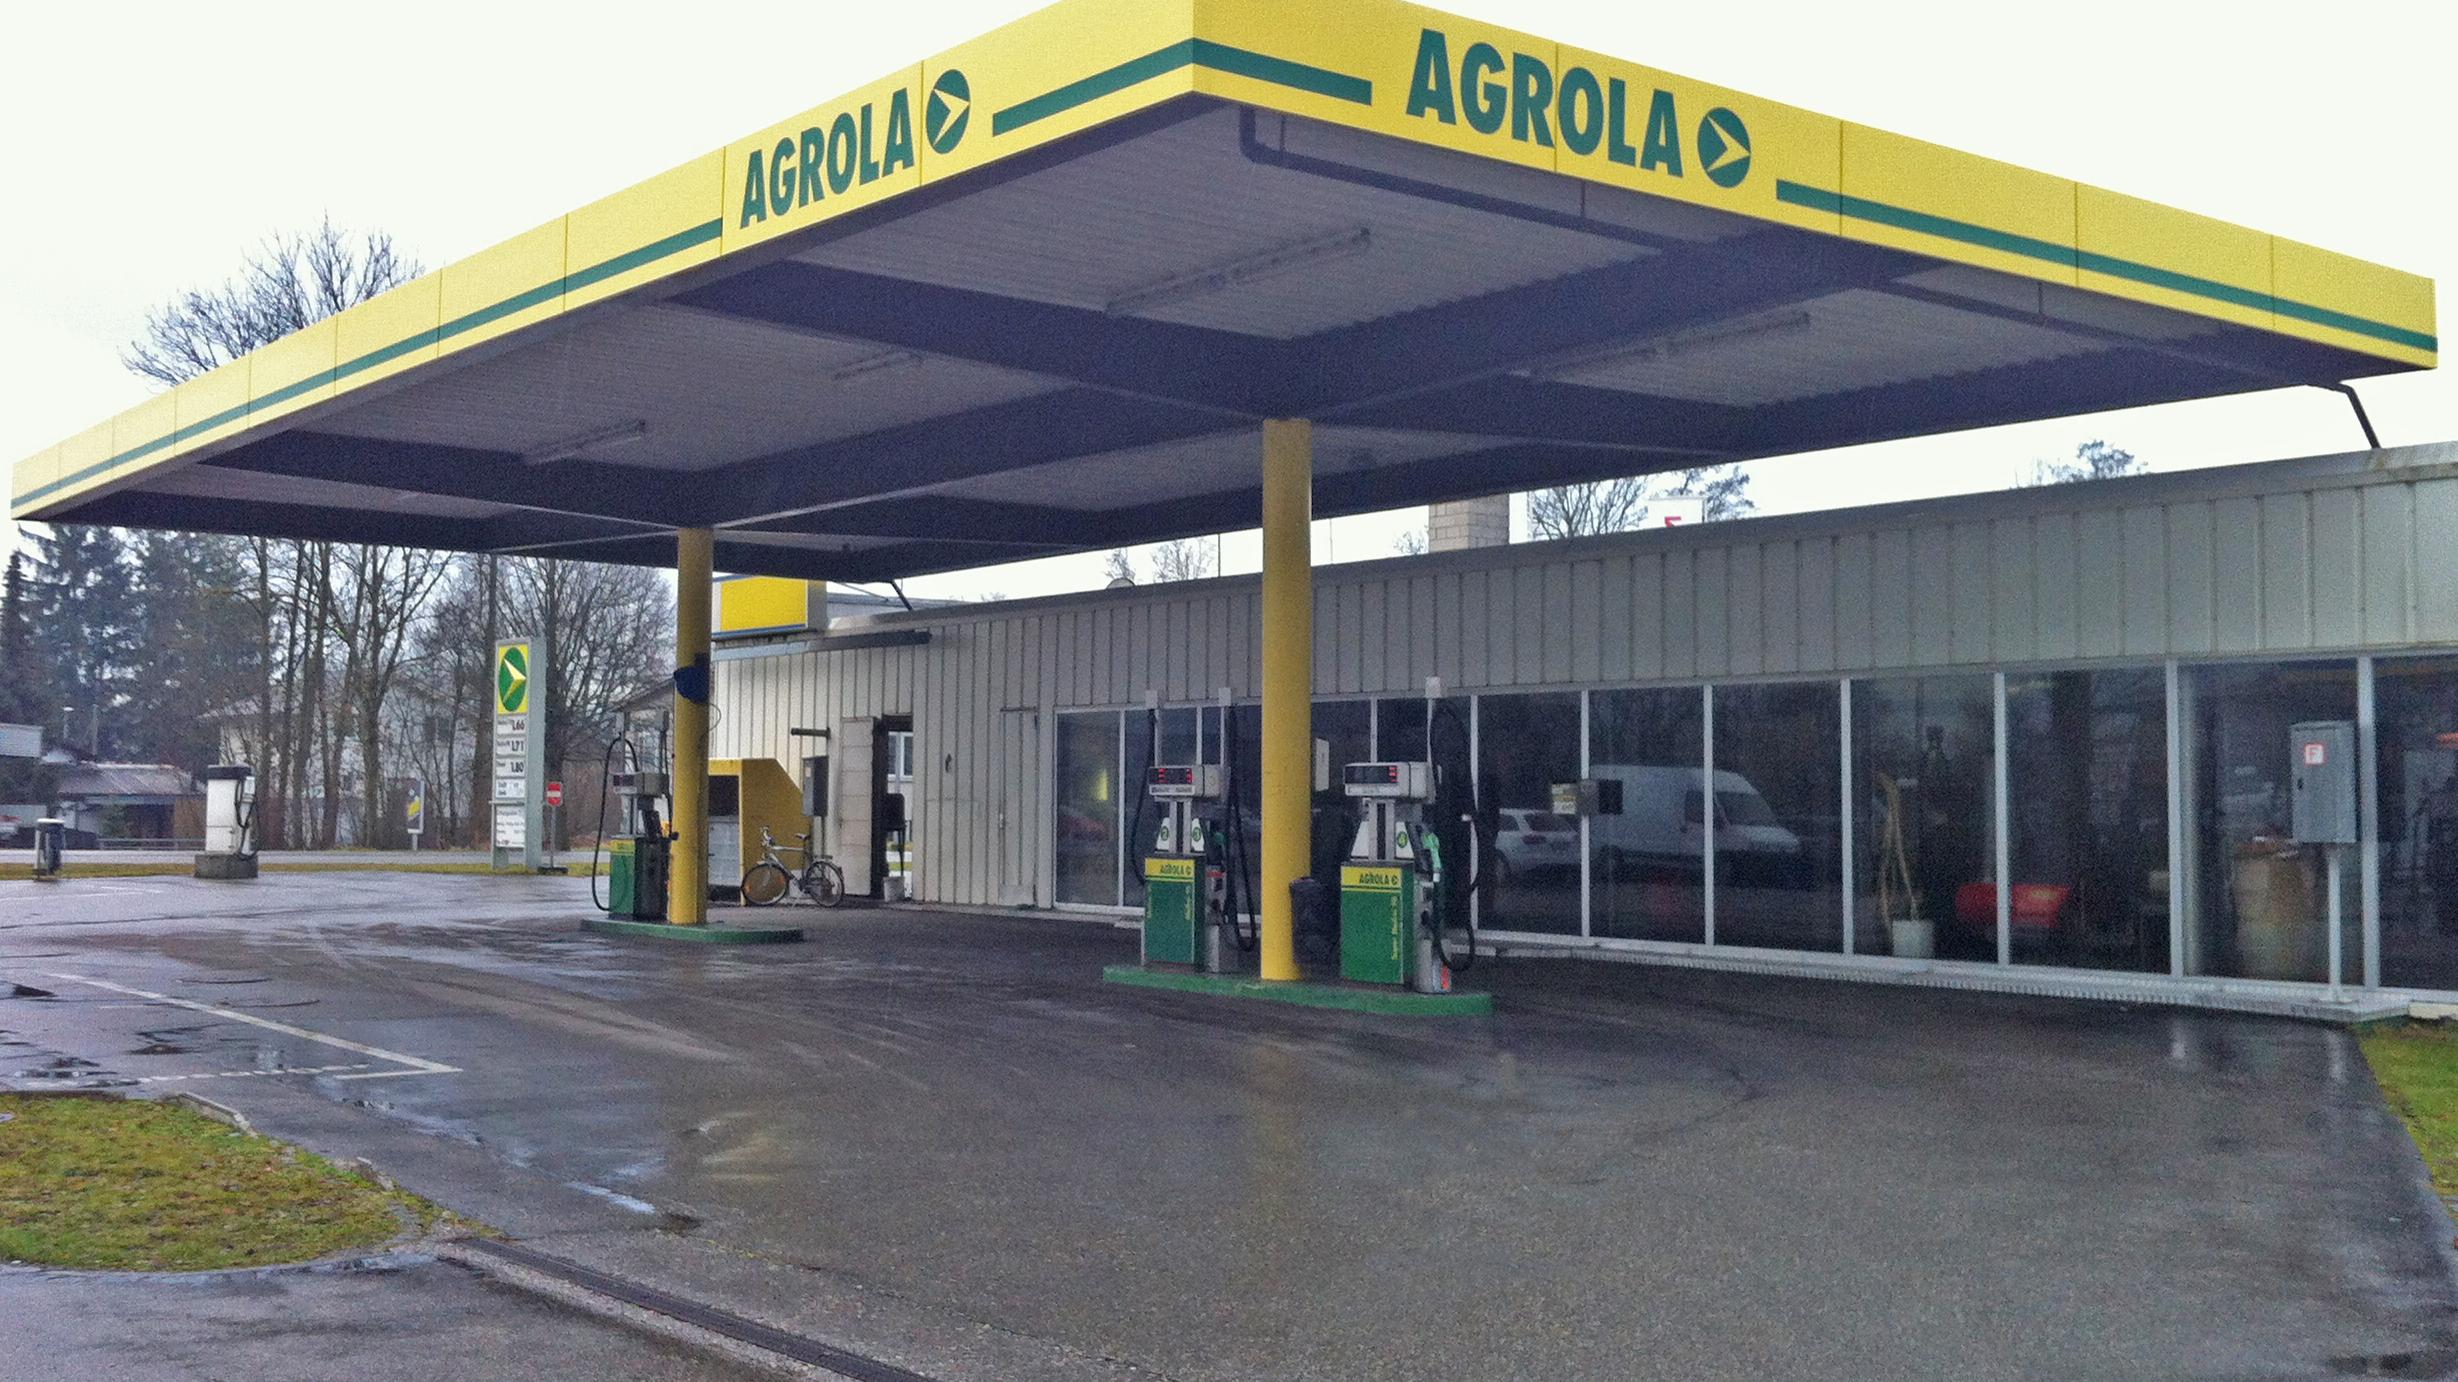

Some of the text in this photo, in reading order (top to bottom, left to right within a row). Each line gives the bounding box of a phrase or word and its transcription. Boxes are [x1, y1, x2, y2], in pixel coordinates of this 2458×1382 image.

[1406, 28, 1684, 178] AGROLA
[740, 87, 915, 229] AGROLA
[1160, 863, 1185, 875] AGROLA
[1360, 872, 1390, 886] AGROLA
